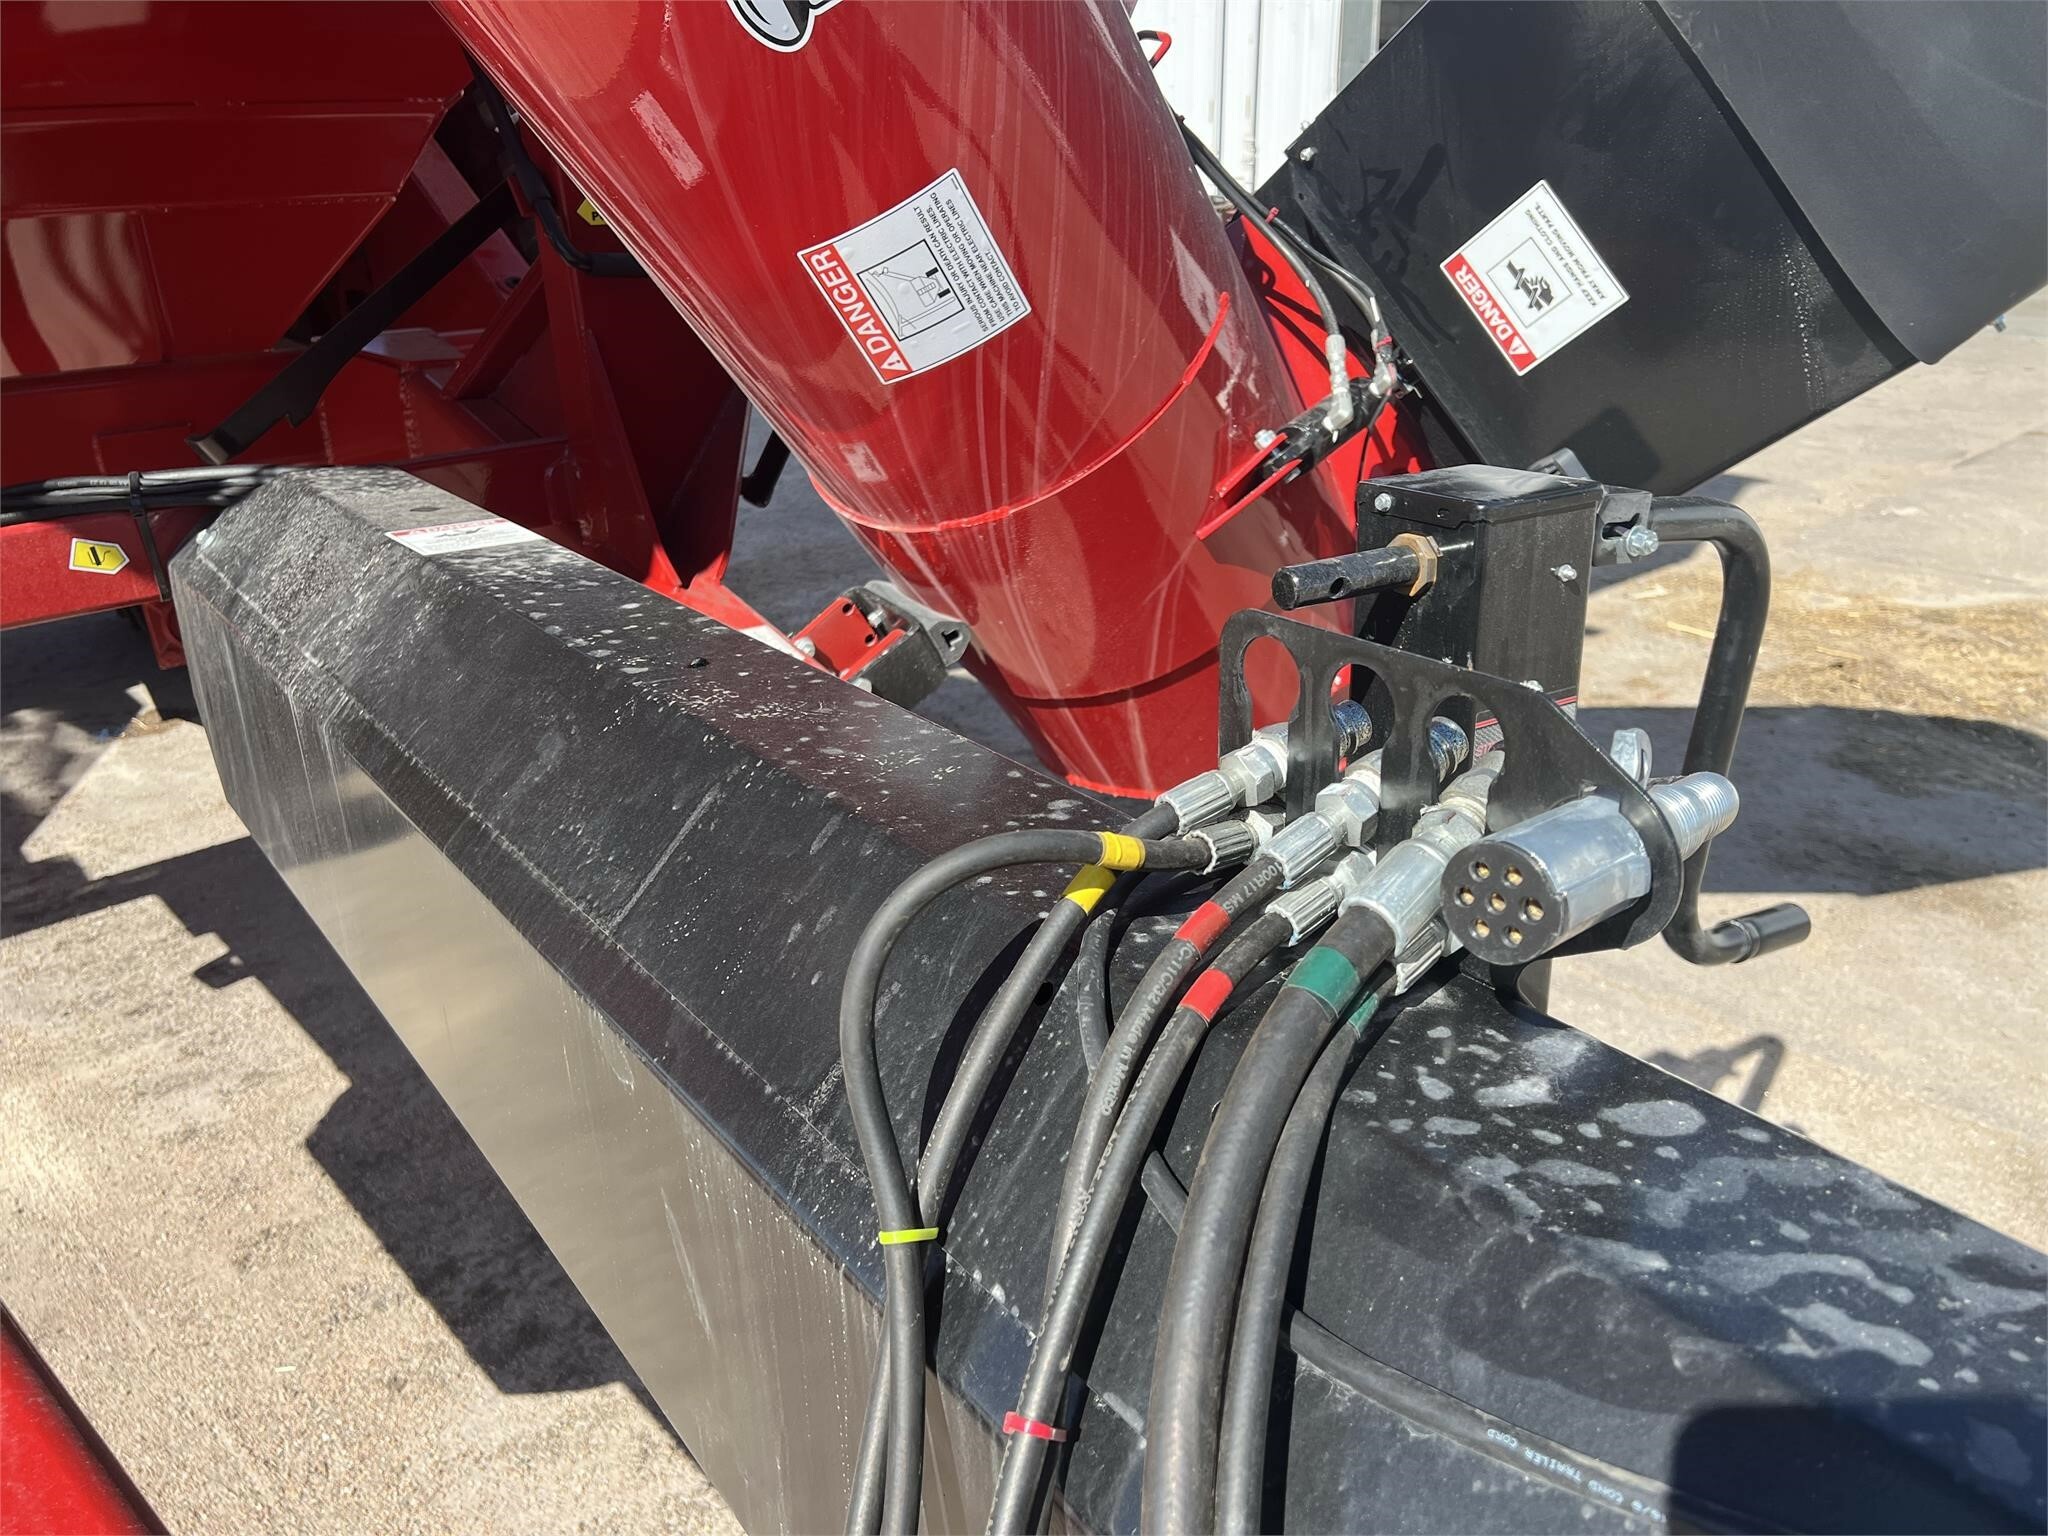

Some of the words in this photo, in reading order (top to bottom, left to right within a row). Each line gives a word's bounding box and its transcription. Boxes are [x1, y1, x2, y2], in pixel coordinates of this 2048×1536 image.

[913, 205, 932, 233] RESULT
[929, 191, 956, 232] OPERATING
[944, 198, 960, 220] LINES
[951, 231, 962, 243] OR
[956, 219, 979, 253] ELECTRIC
[1524, 208, 1552, 245] CLOTHING
[928, 232, 941, 248] CAN
[937, 227, 960, 261] ELECTRIC
[1552, 228, 1574, 257] MOVING
[937, 247, 953, 271] DEATH
[957, 242, 976, 270] MOVING
[975, 253, 989, 272] NEAR
[1550, 245, 1564, 262] AND
[949, 270, 959, 282] OR
[955, 260, 970, 278] WITH
[972, 269, 987, 290] WHEN
[1562, 261, 1583, 286] HANDS
[1572, 258, 1589, 278] FROM
[956, 281, 972, 305] INJURY
[965, 278, 986, 309] CONTACT
[983, 289, 998, 308] CARE
[985, 271, 1005, 302] MACHINE
[1001, 280, 1016, 301] AVOID
[809, 247, 891, 354] DANGER
[1001, 300, 1013, 316] THIS
[1012, 300, 1021, 311] TO
[1453, 264, 1513, 340] DANGER
[969, 303, 988, 332] SERIOUS
[982, 307, 997, 327] FROM
[993, 307, 1005, 322] USE
[1244, 861, 1283, 898] 100R17
[1128, 1004, 1153, 1043] Made
[1120, 1046, 1134, 1060] in
[1103, 1063, 1128, 1115] Mexico
[1487, 1428, 1517, 1447] CORD
[1524, 1447, 1581, 1482] TRAILER
